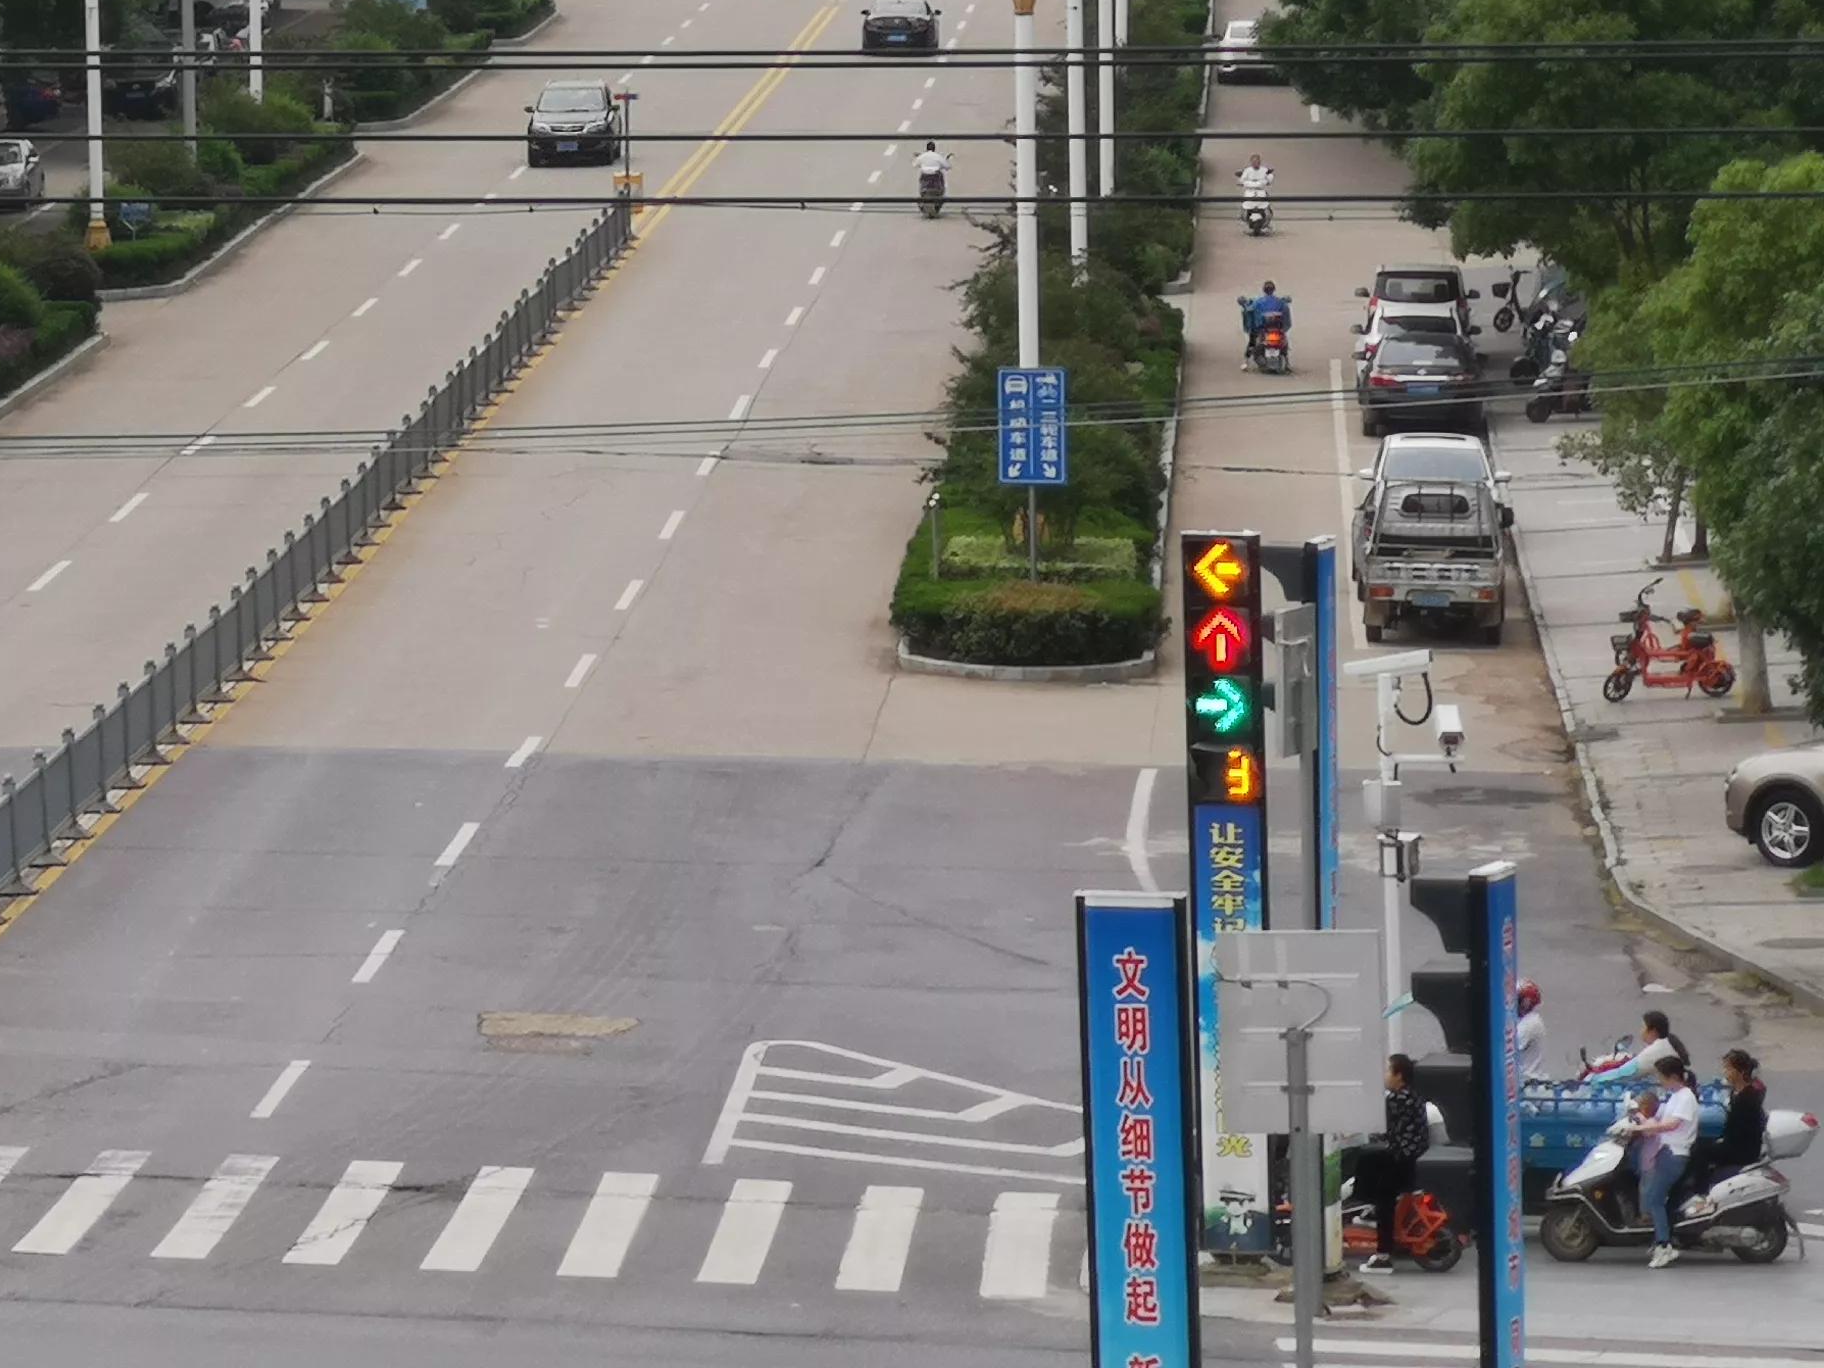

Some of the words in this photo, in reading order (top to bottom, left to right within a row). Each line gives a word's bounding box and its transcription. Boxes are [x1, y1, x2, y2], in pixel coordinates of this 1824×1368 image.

[1227, 749, 1250, 796] 3
[1113, 948, 1159, 1326] 文明从细节做起
